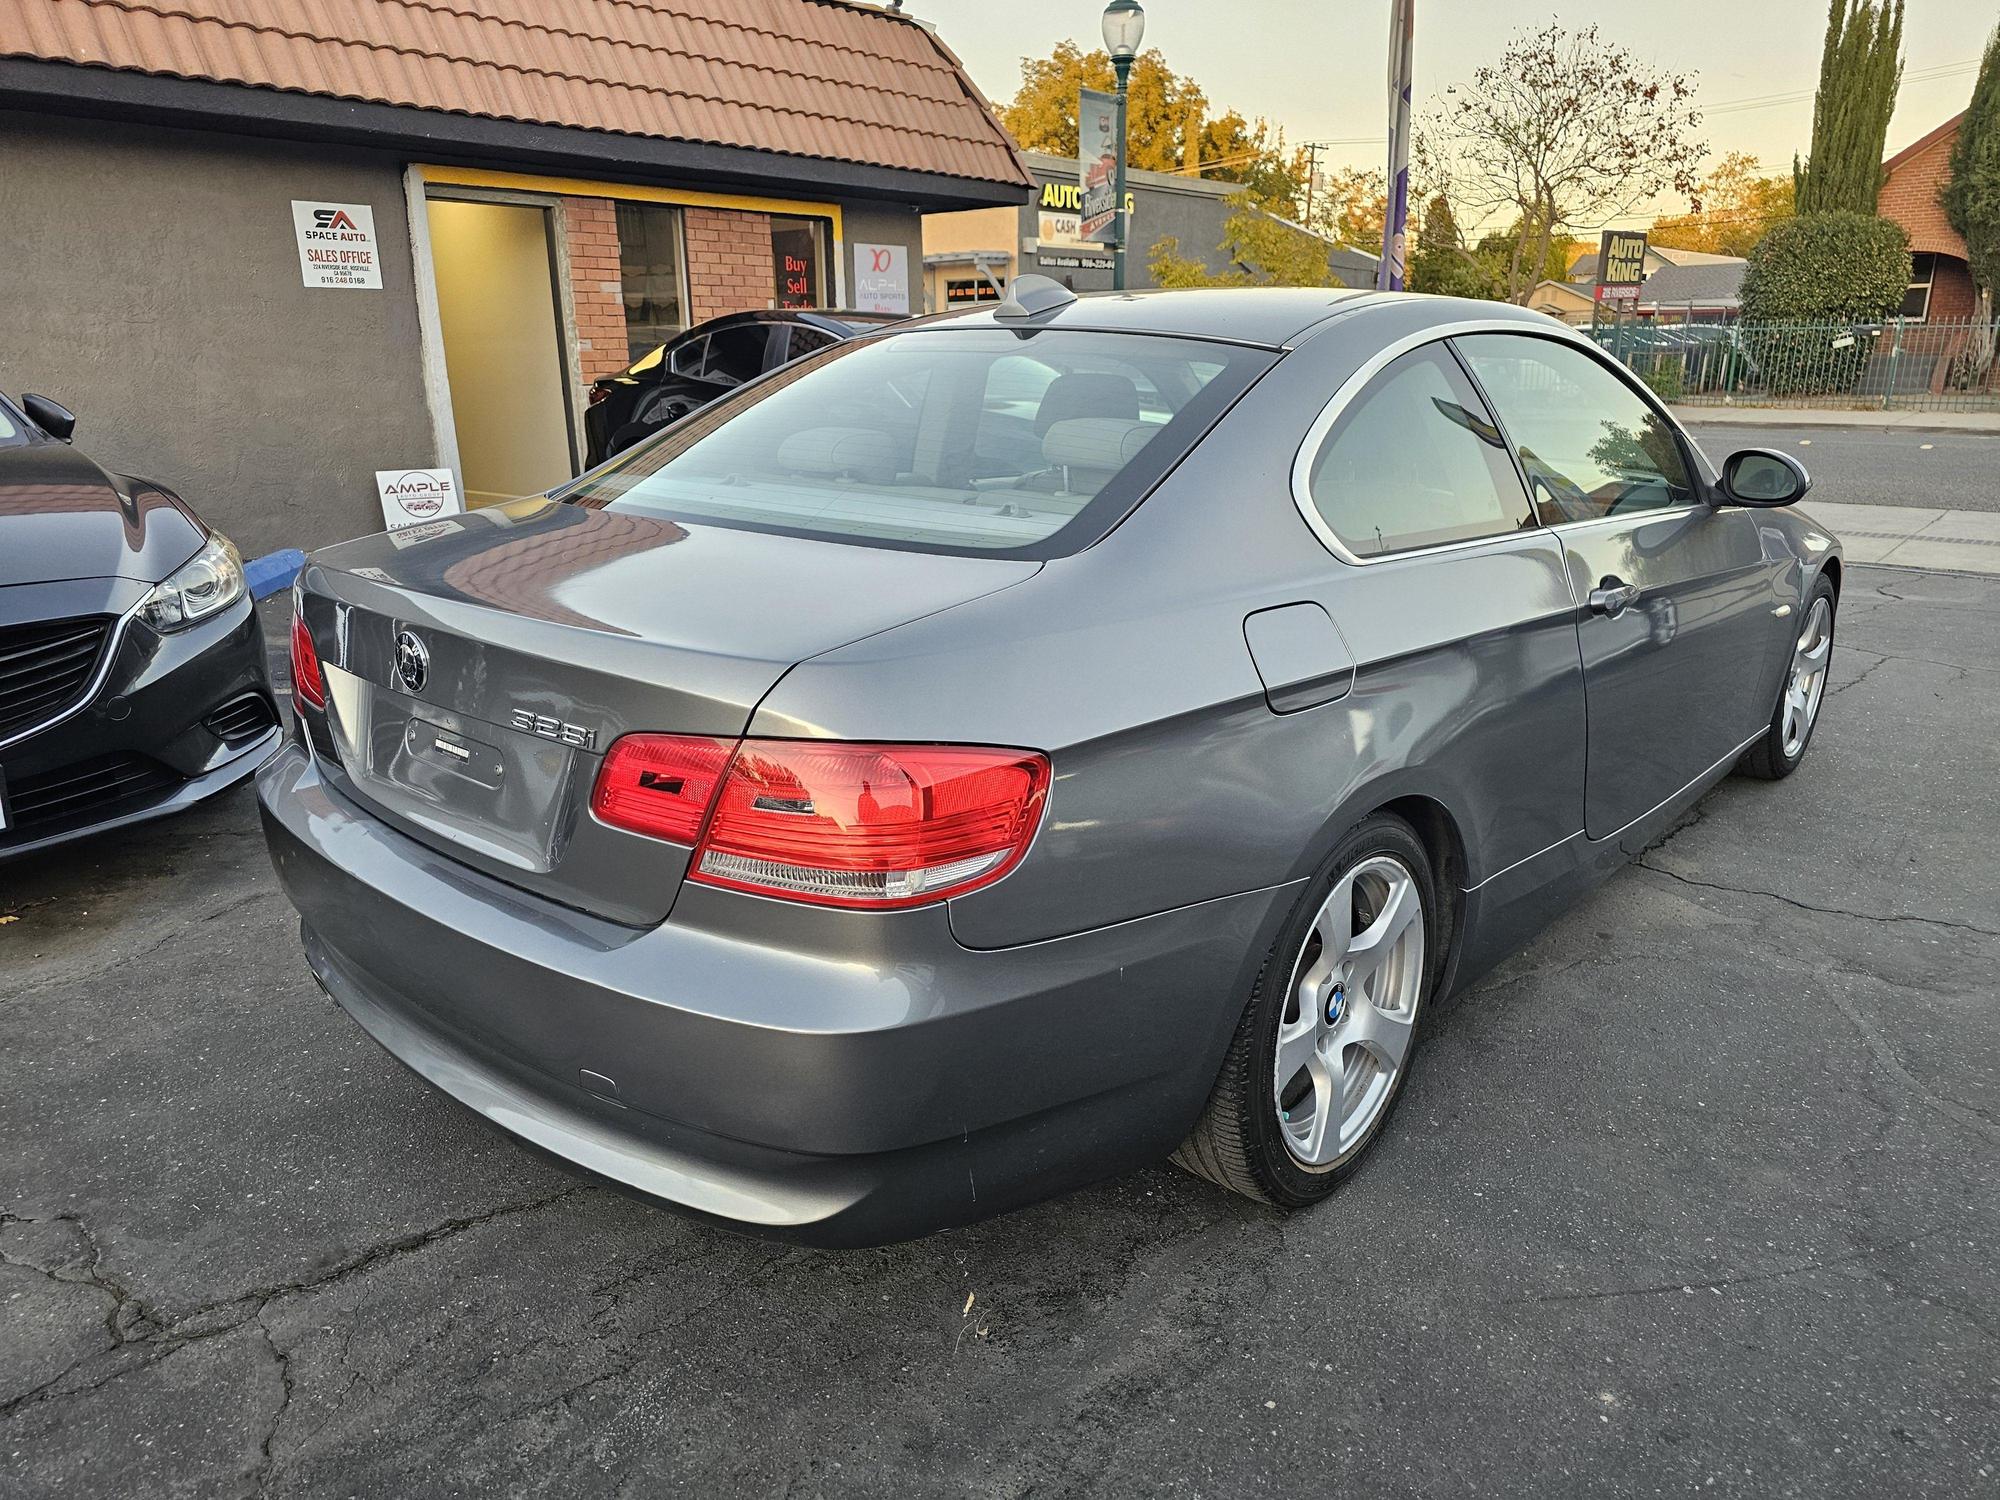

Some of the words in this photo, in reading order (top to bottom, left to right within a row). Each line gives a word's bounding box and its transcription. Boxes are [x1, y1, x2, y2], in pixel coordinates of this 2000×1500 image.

[1055, 219, 1076, 234] CASH
[305, 230, 338, 241] SPACE
[340, 232, 366, 242] AUTO
[1607, 235, 1645, 259] AUTO
[307, 248, 338, 263] SALES
[340, 250, 373, 264] OFFICE
[785, 255, 807, 277] Buy
[1605, 258, 1641, 282] KING
[321, 276, 334, 284] 916
[787, 278, 807, 294] Sell
[384, 481, 451, 495] AMPLE
